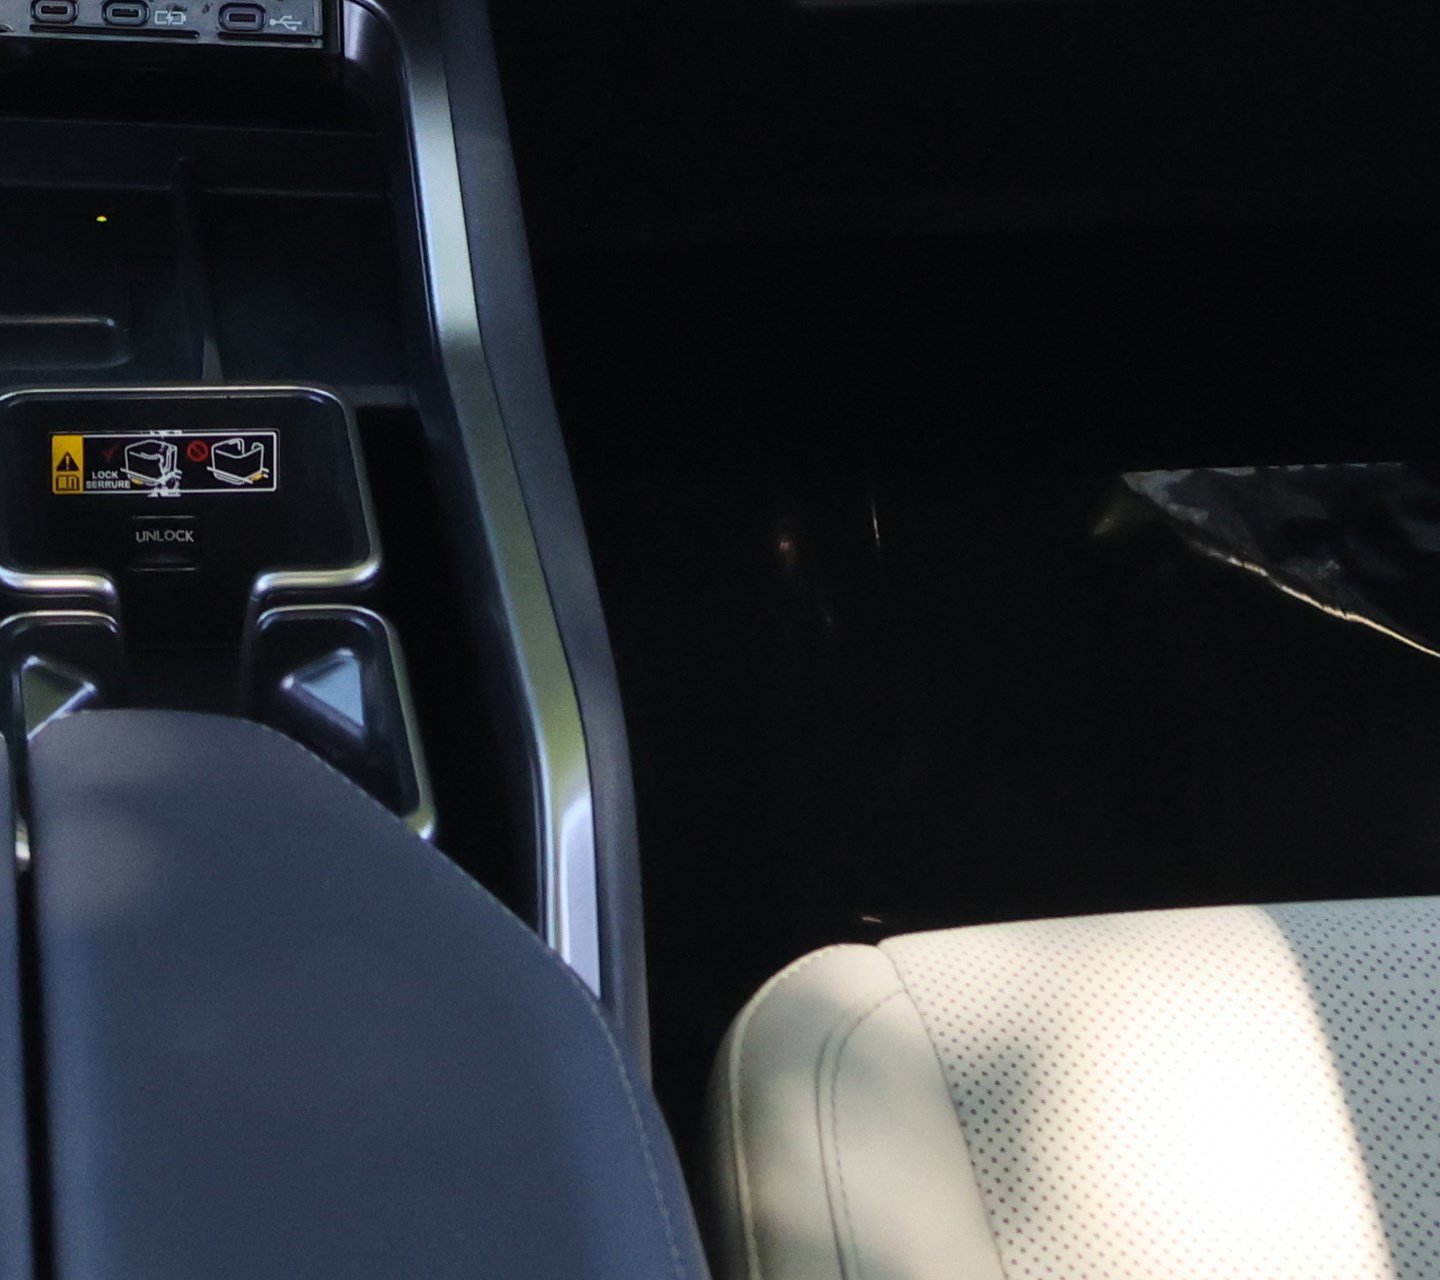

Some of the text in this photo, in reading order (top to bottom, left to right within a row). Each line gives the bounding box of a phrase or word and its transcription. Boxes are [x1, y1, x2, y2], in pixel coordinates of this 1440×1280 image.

[91, 470, 119, 480] LOCK
[85, 480, 131, 490] SERRURE
[135, 530, 195, 543] UNLOCK
